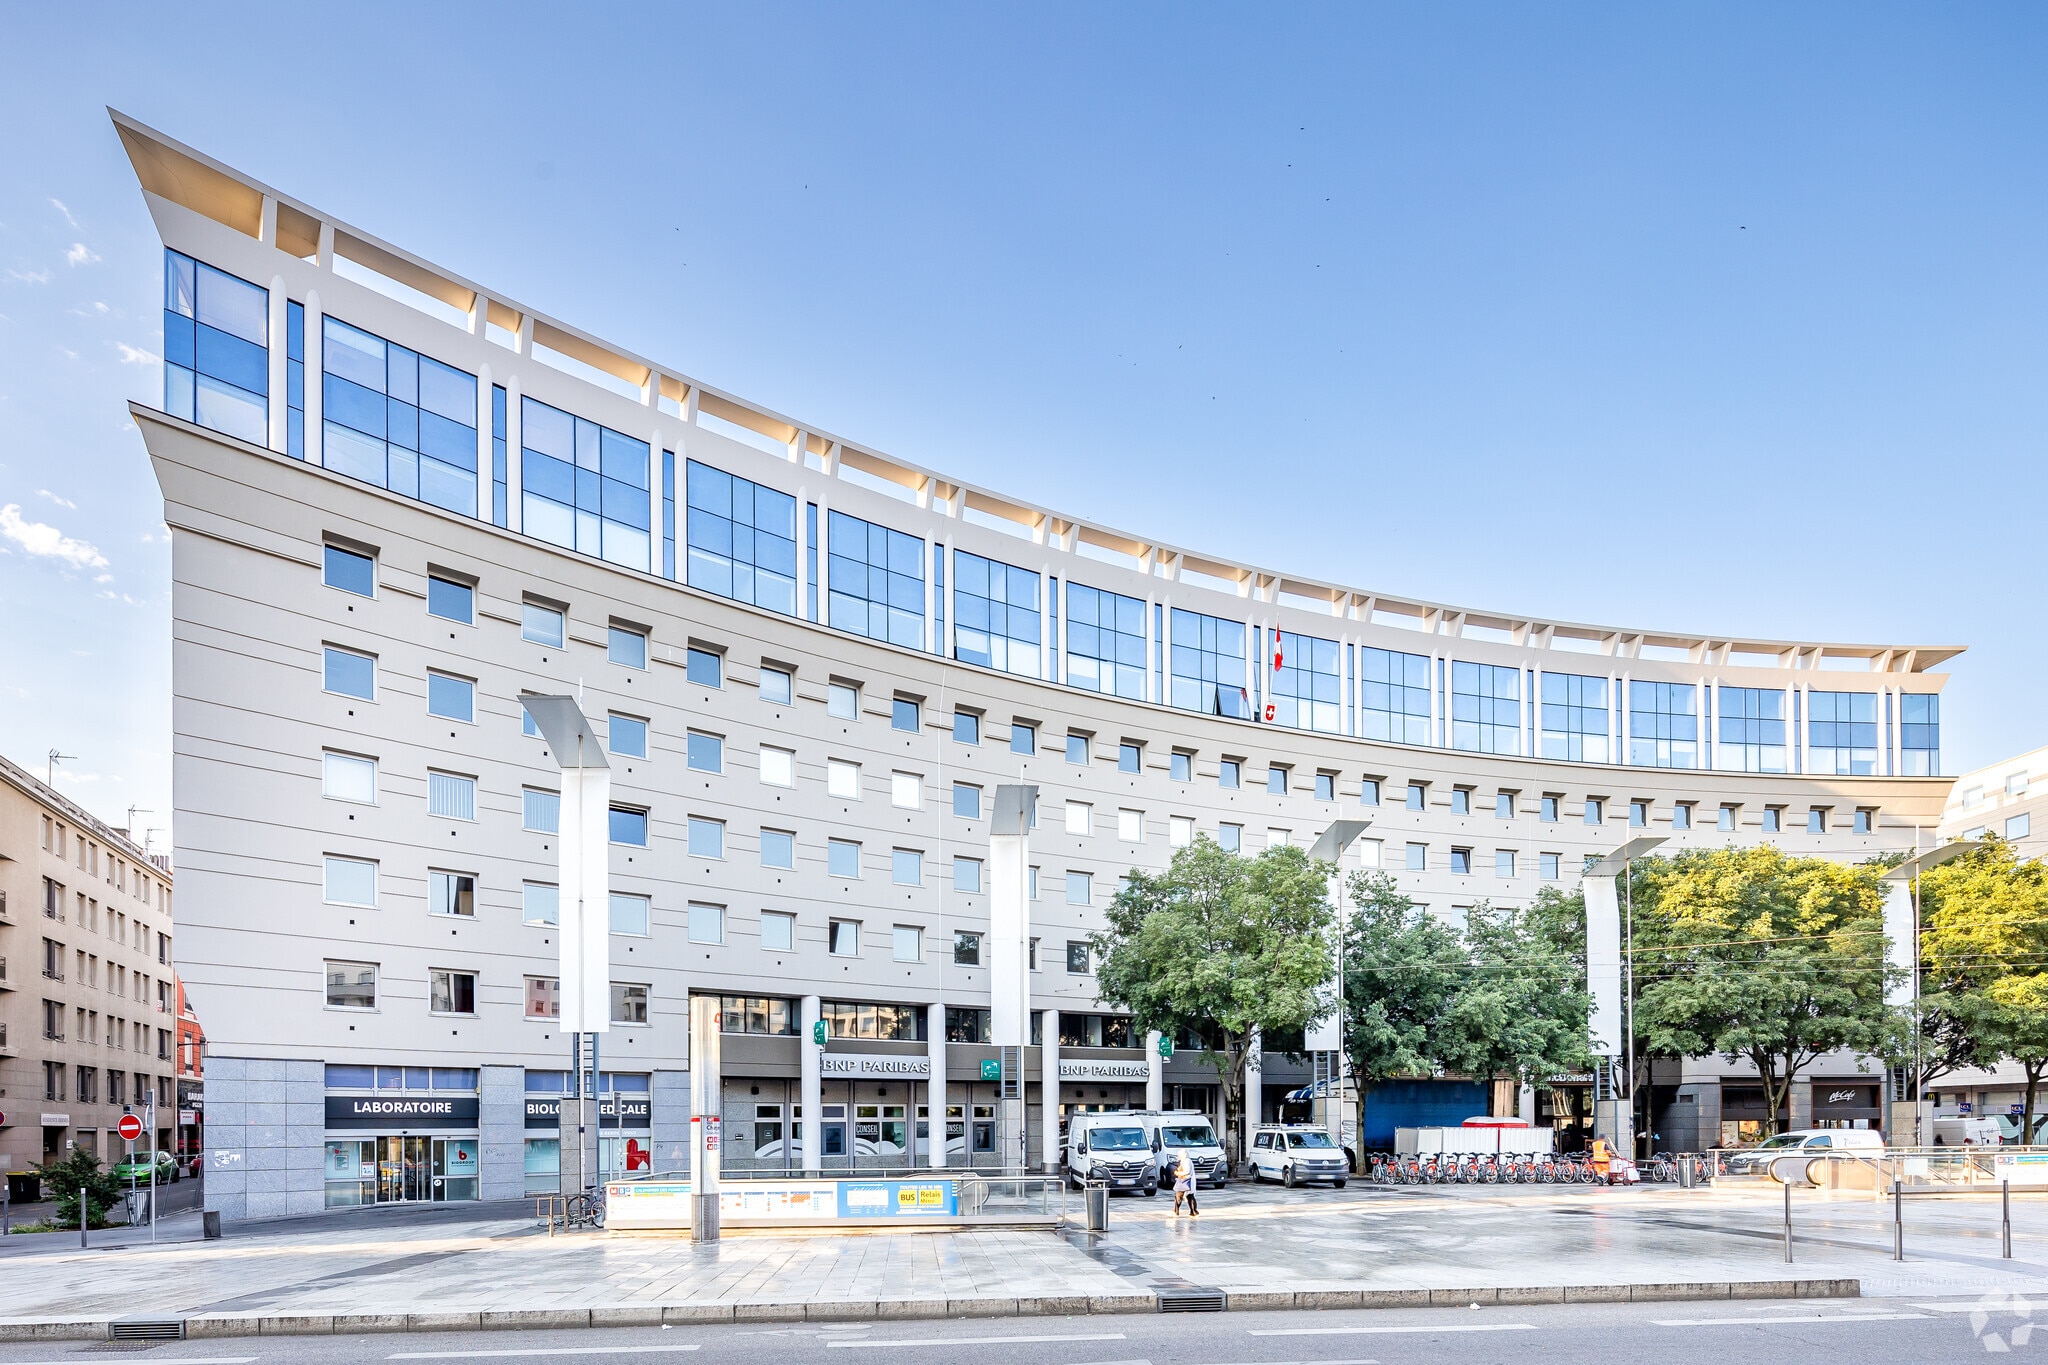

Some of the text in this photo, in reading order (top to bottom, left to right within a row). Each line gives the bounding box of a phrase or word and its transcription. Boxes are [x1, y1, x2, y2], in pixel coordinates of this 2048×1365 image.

[823, 1060, 930, 1074] BNP PARIBAS
[1060, 1065, 1150, 1077] BNP PARIBAS
[353, 1101, 452, 1113] LABORATOIRE
[599, 1104, 647, 1115] EDCALE
[856, 1124, 879, 1133] CONSEIL
[946, 1124, 963, 1133] ONSEIL
